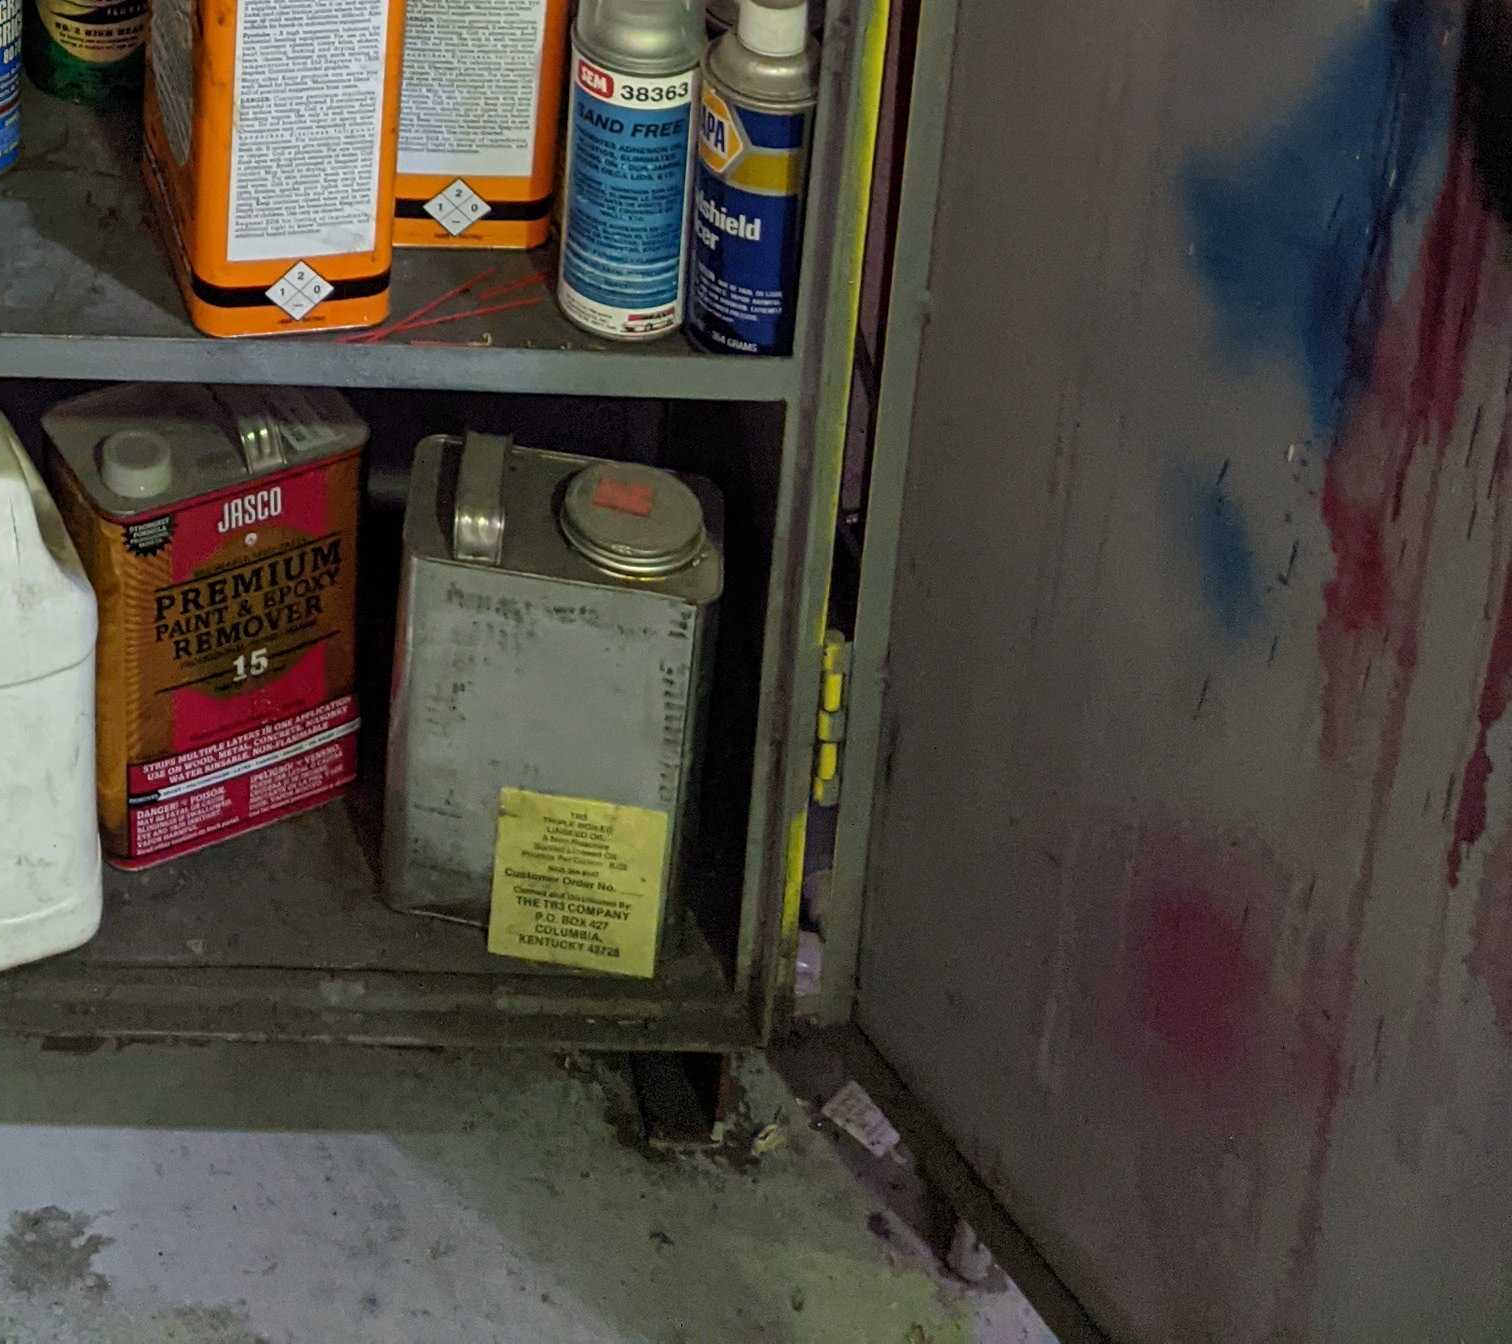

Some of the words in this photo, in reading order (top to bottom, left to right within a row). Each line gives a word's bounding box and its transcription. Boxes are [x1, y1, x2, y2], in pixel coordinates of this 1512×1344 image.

[581, 65, 608, 94] SEM
[619, 81, 689, 103] 38363
[631, 118, 687, 140] FREE
[455, 188, 462, 198] 2
[471, 203, 478, 212] 0
[297, 271, 305, 281] 2
[313, 284, 320, 294] 0
[217, 485, 282, 534] JASCO
[154, 538, 343, 624] PREMIUM
[154, 607, 228, 643] PAINT
[237, 599, 251, 619] &
[263, 566, 341, 610] EPOXY
[172, 594, 325, 661] REMOVER
[231, 647, 270, 683] 15
[143, 756, 177, 774] STRIPS
[177, 744, 226, 765] MULTIPLE
[225, 730, 261, 750] LAYERS
[274, 718, 293, 732] ONE
[292, 695, 353, 725] APPLICATION
[146, 768, 167, 781] USE
[167, 765, 183, 777] ON
[168, 768, 203, 785] WATER
[504, 867, 560, 884] Customer
[562, 876, 595, 890] Order
[597, 881, 617, 893] No.
[516, 895, 543, 909] THE
[567, 902, 630, 922] COMPANY
[534, 923, 604, 944] COLUMBIA,
[561, 914, 587, 928] BOX
[589, 919, 610, 931] 427
[517, 932, 586, 953] KENTUCKY
